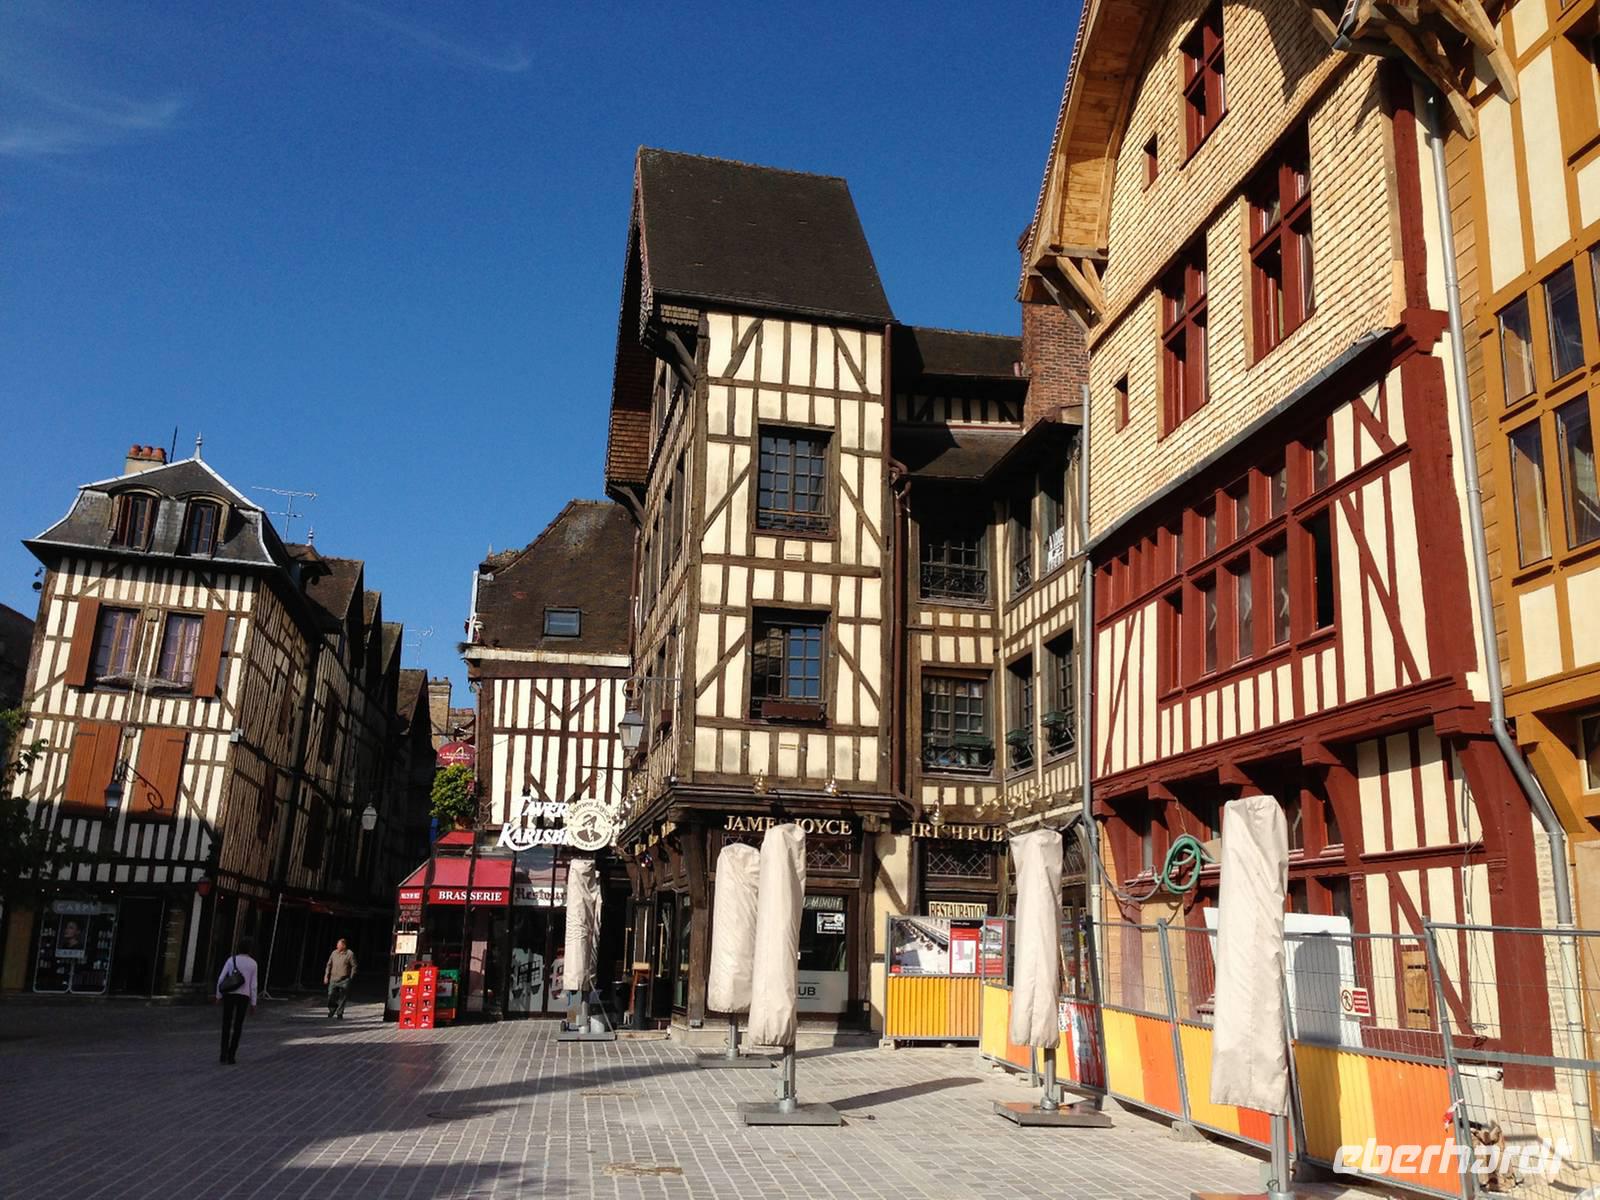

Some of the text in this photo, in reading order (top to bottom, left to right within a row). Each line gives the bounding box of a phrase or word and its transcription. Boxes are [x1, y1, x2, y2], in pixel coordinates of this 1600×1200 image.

[510, 796, 570, 818] TAVER
[911, 822, 1004, 842] IRISH PUB
[438, 891, 502, 902] BRASSERIE
[929, 903, 988, 918] RESTAURATION
[797, 986, 816, 996] UB
